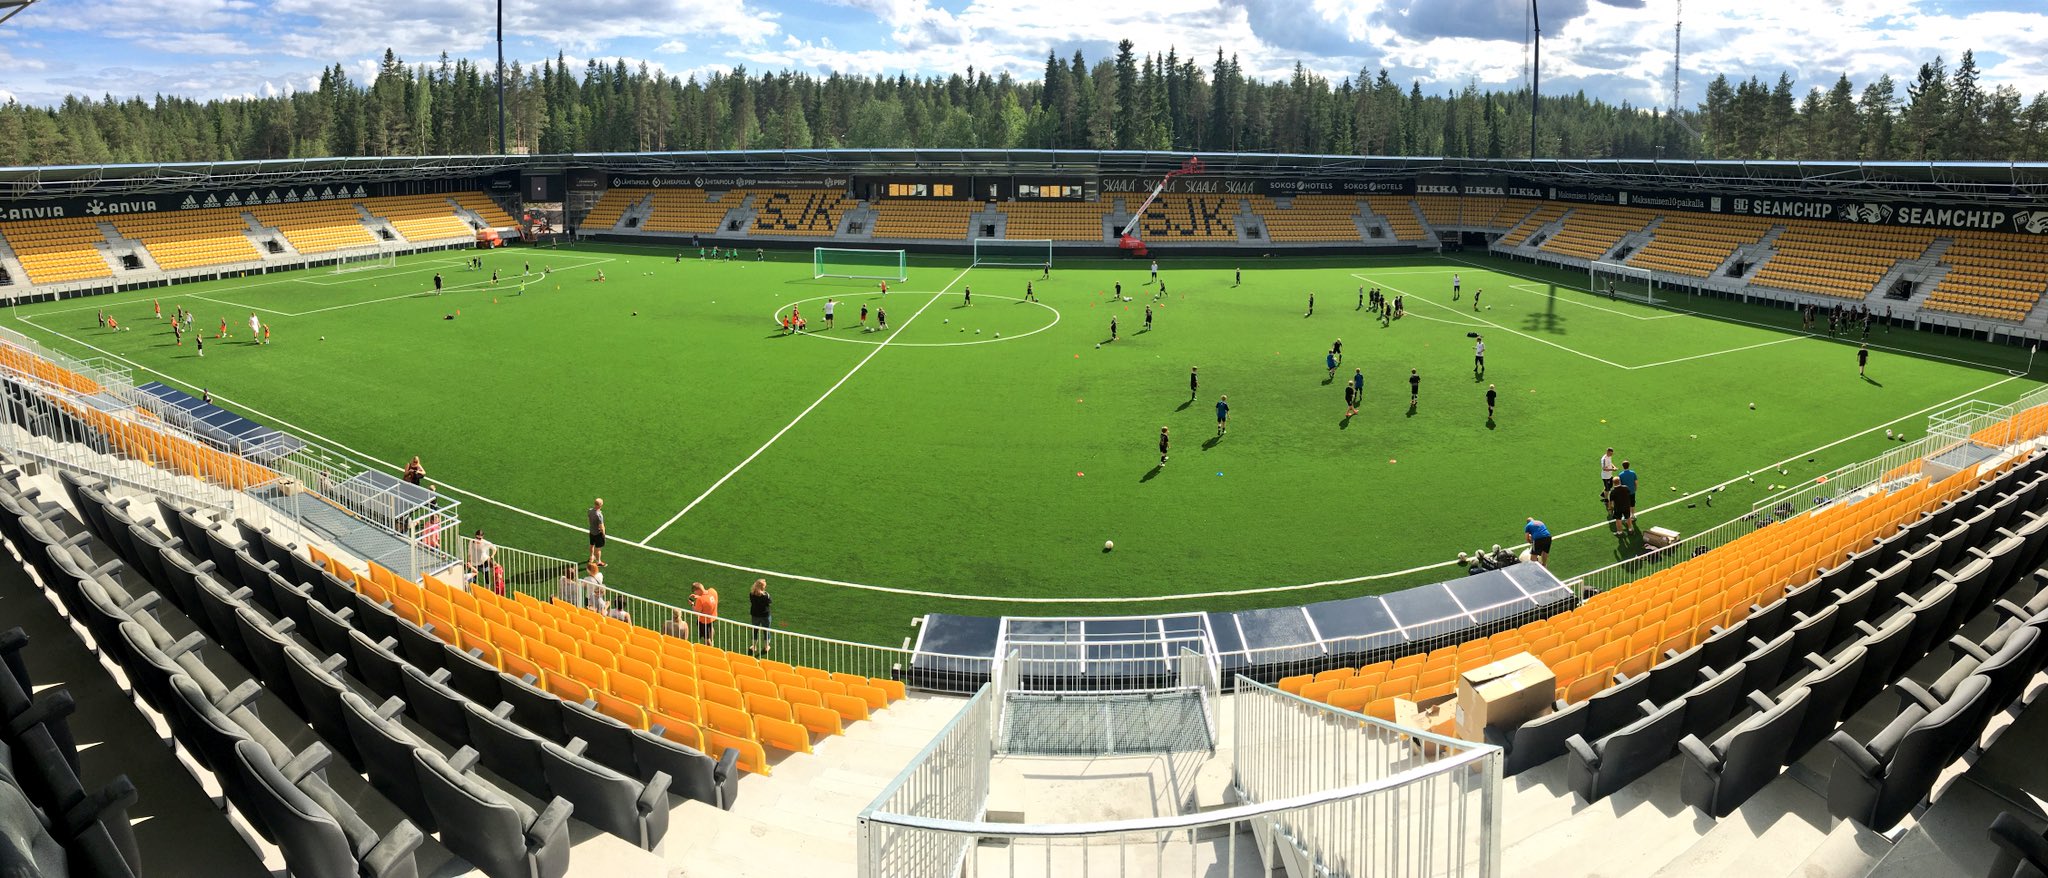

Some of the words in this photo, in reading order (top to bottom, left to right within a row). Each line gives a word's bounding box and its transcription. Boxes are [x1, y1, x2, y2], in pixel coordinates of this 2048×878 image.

[1103, 179, 1136, 192] SKAALA
[1185, 180, 1219, 193] SKAALA
[1270, 182, 1296, 190] SOKOS
[1304, 182, 1333, 190] HOTELS
[1417, 185, 1458, 194] ILKKA
[1465, 186, 1504, 195] ILKKA
[1509, 187, 1542, 197] ILKKA
[9, 206, 64, 220] ANVIA
[109, 201, 157, 214] ANVIA
[757, 193, 846, 230] SJK
[1753, 199, 1832, 218] SEAMCHIP
[1144, 198, 1233, 235] SJK
[1897, 207, 2006, 229] SEAMCHIP
